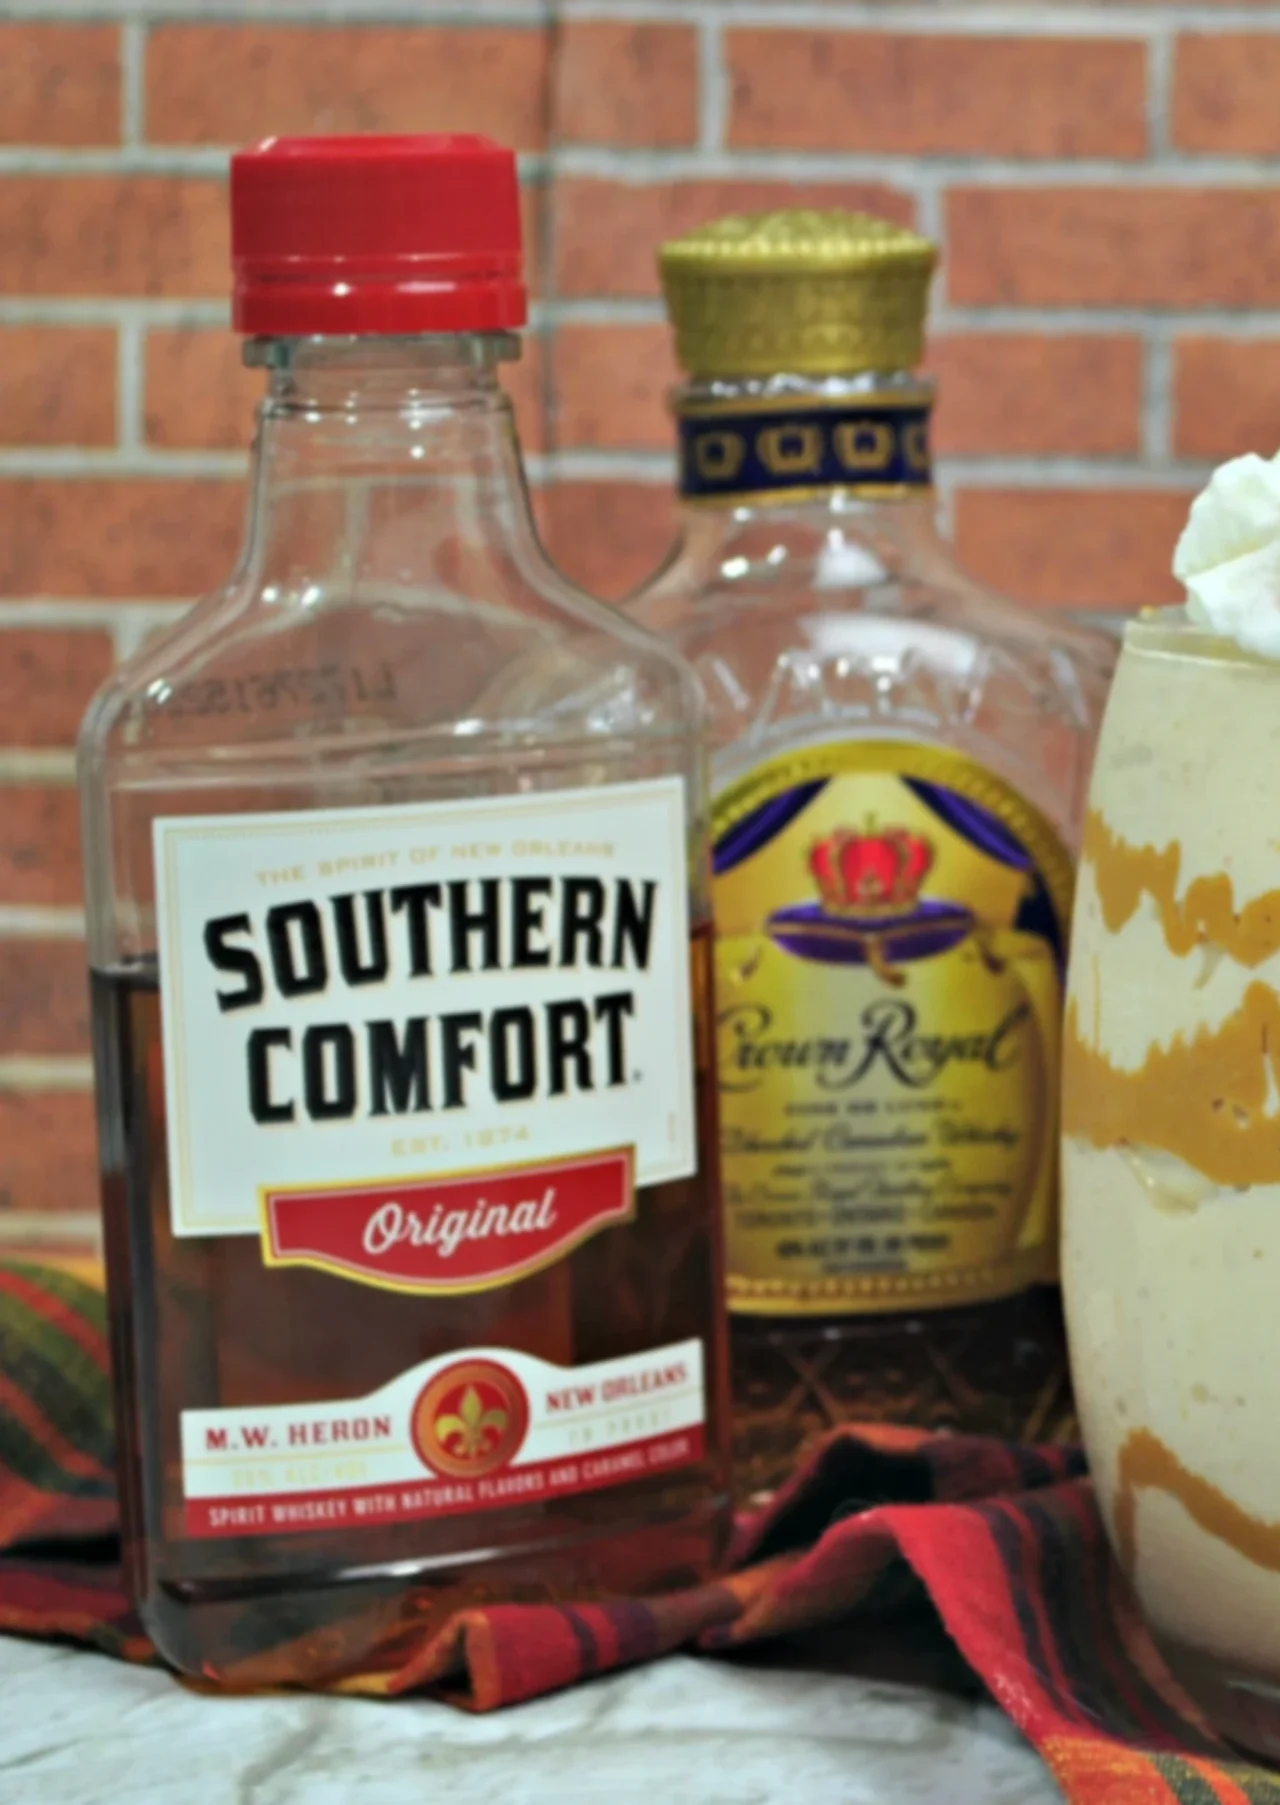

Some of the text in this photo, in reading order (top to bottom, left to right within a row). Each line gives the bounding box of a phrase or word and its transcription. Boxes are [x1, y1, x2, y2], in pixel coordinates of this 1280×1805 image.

[257, 839, 616, 887] THE SPIRIT OF NEW ORLEANS
[203, 875, 657, 1014] SOUTHERN
[246, 990, 637, 1126] COMFORT
[717, 999, 1032, 1094] Crown Royal
[362, 1186, 558, 1259] Original
[545, 1361, 688, 1414] NEW ORLEANS
[205, 1414, 392, 1452] M.W. HERON
[208, 1504, 266, 1529] SPIRIT
[271, 1497, 347, 1524] WHISKEY
[352, 1492, 397, 1516] WITH
[402, 1483, 474, 1511] NATURAL
[477, 1471, 545, 1500] FLAVORS
[549, 1465, 580, 1487] AND
[582, 1448, 646, 1482] CARAMEL
